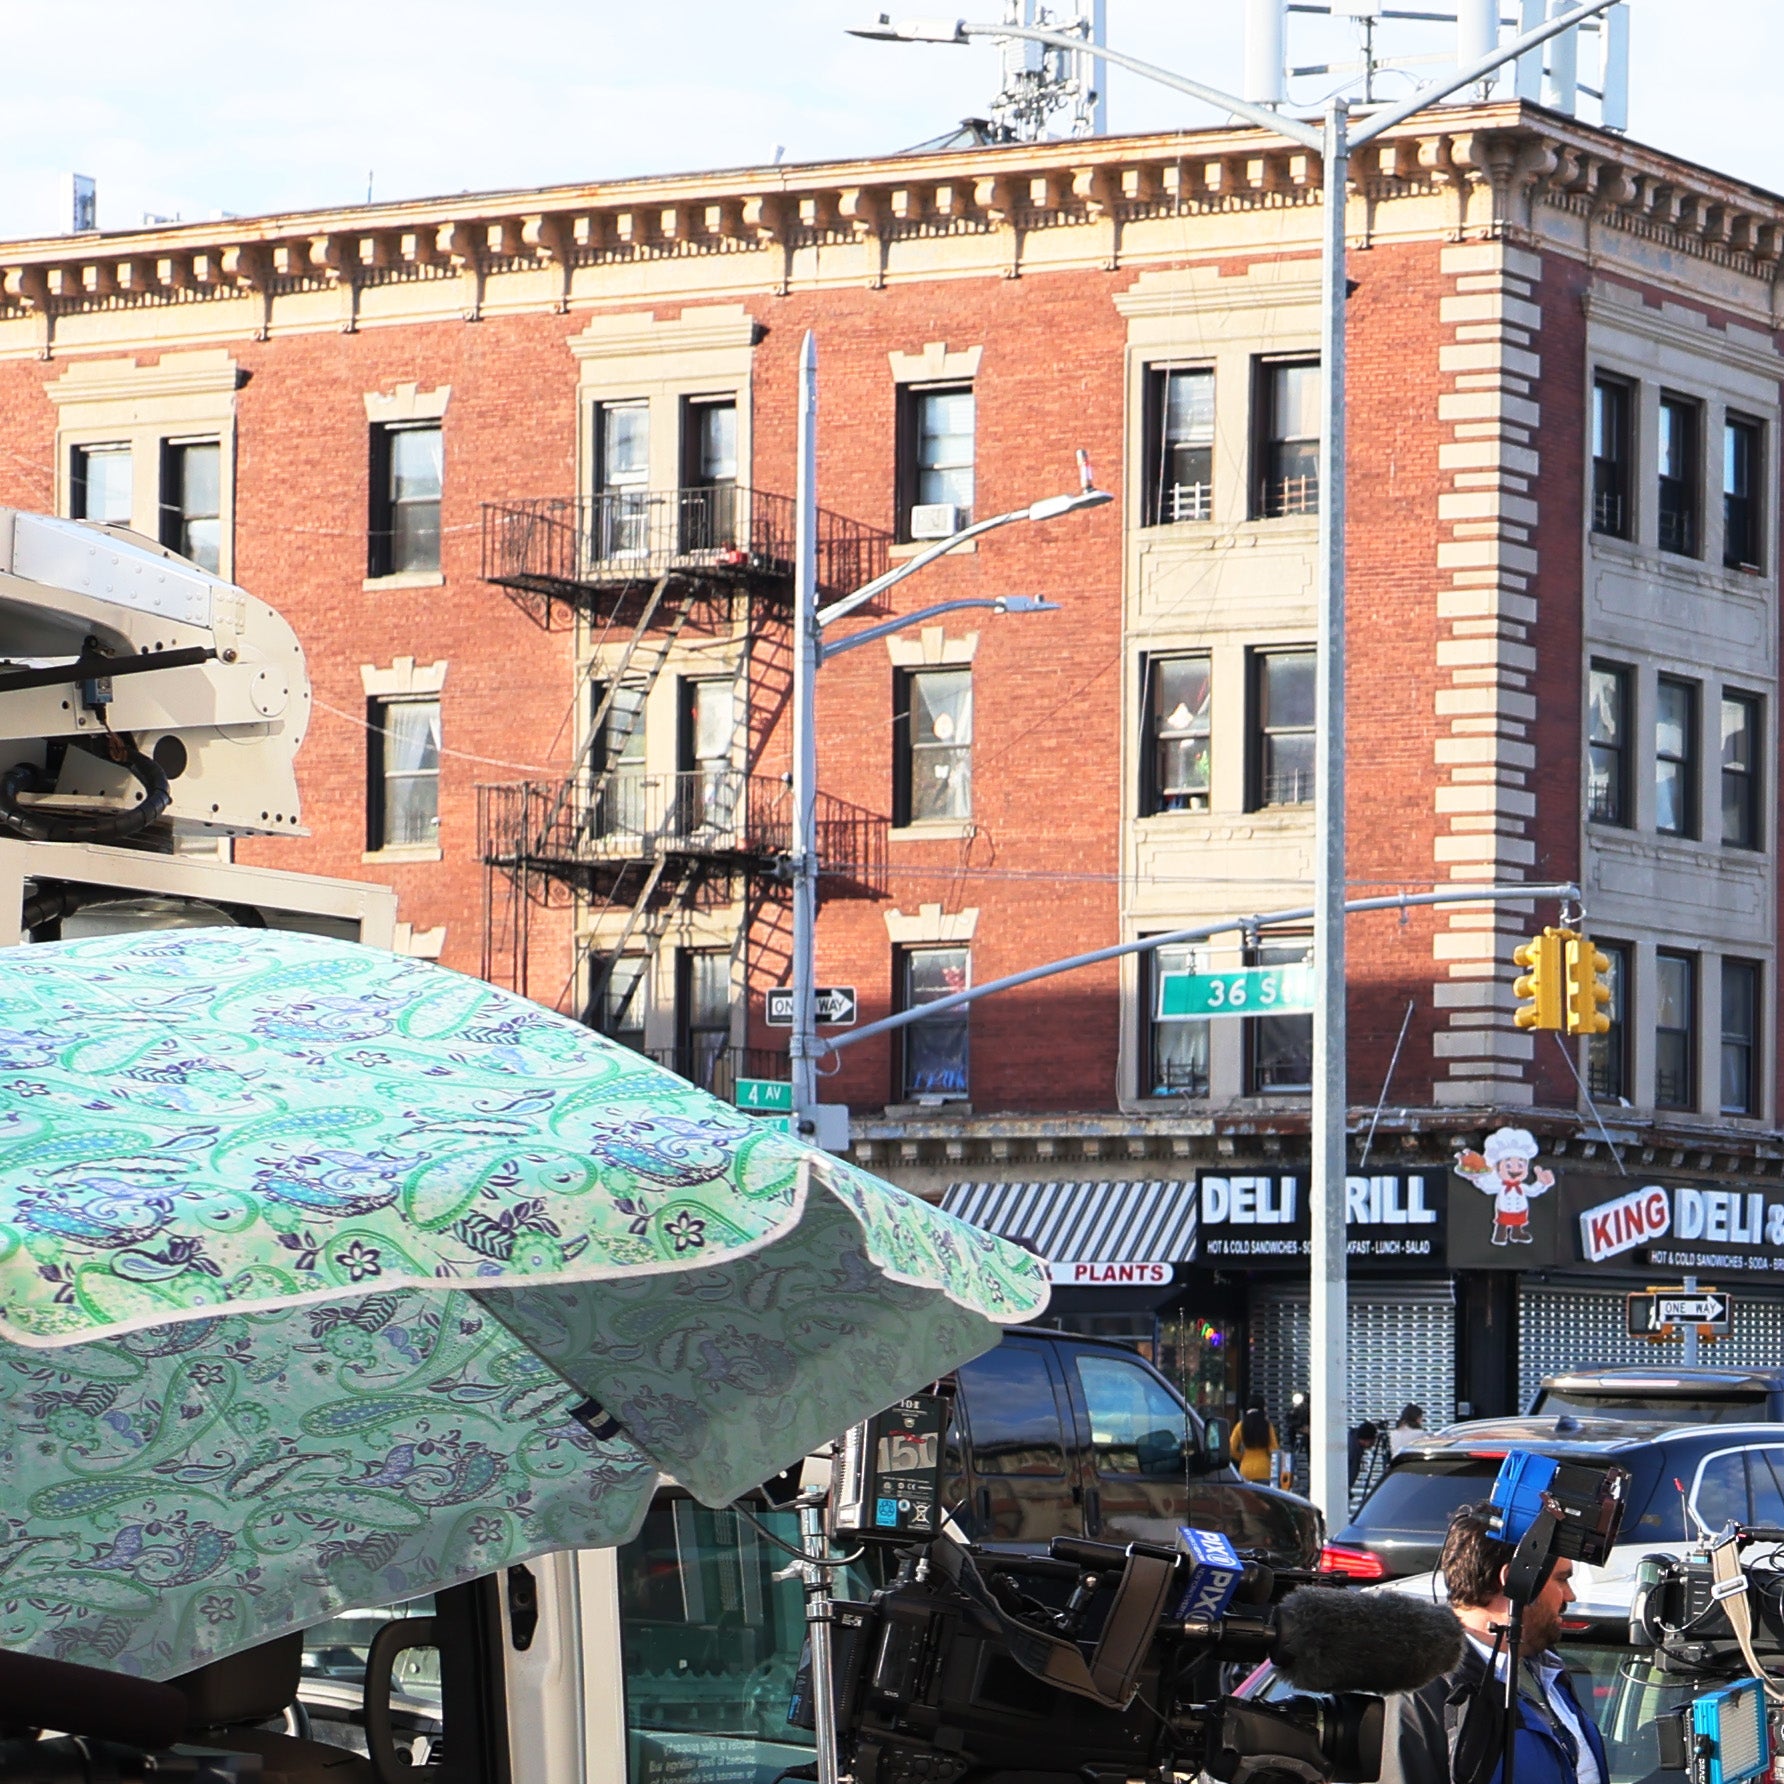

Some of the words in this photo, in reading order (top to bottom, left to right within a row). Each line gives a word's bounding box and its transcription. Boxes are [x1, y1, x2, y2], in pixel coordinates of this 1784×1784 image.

[1207, 978, 1247, 1007] 36
[775, 1000, 794, 1014] ON
[818, 998, 844, 1012] WAY
[748, 1084, 758, 1105] 4
[765, 1086, 783, 1100] AV
[1201, 1176, 1297, 1224] DELI
[1345, 1176, 1436, 1224] RILL
[1591, 1192, 1666, 1255] KING
[1674, 1188, 1764, 1244] DELI
[1207, 1240, 1223, 1254] HOT
[1230, 1240, 1250, 1255] COLD
[1250, 1240, 1297, 1255] SANDWICHES
[1375, 1241, 1400, 1255] LUNCH
[1405, 1241, 1430, 1255] SALAD
[1651, 1250, 1667, 1265] HOT
[1675, 1252, 1695, 1267] COLD
[1696, 1254, 1743, 1269] SANDWICHES
[1748, 1257, 1768, 1271] SODA
[1074, 1264, 1164, 1282] PLANTS
[1664, 1302, 1686, 1315] ONE
[1695, 1302, 1717, 1314] WAY
